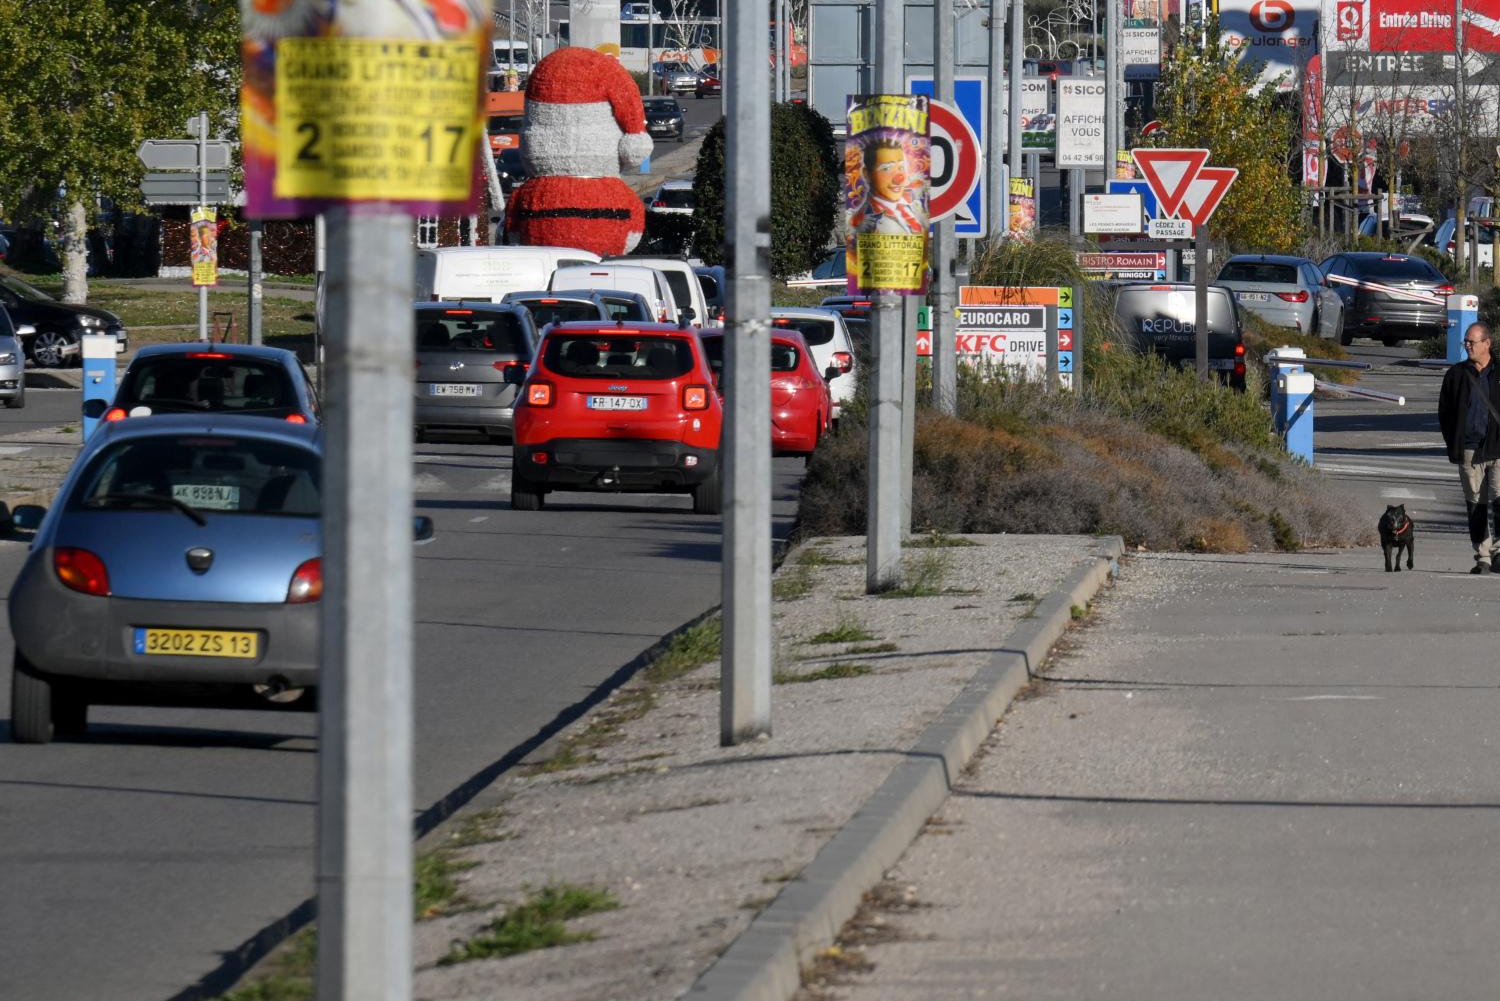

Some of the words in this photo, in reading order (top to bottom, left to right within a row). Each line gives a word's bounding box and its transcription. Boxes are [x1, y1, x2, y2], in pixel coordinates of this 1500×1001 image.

[1379, 11, 1418, 28] Entrée
[1420, 11, 1452, 28] Drive
[1229, 34, 1312, 49] boulanger
[1345, 51, 1425, 72] ENTRÉE
[1074, 85, 1105, 95] SICO
[849, 105, 928, 136] BENZINI
[1071, 128, 1101, 137] VOUS
[296, 122, 322, 161] 2
[420, 125, 465, 163] 17
[931, 135, 954, 188] 0
[1155, 220, 1175, 228] CÉDEZ
[859, 240, 882, 249] GRAND
[883, 241, 922, 249] LITTORAL
[862, 261, 871, 276] 2
[1082, 257, 1114, 266] BISTRO
[903, 262, 920, 277] 17
[960, 312, 1030, 325] EUROCARO
[955, 334, 1007, 352] KFC
[1009, 340, 1044, 352] DRIVE
[149, 632, 194, 652] 3202
[200, 633, 223, 653] ZS
[230, 635, 252, 654] 13
